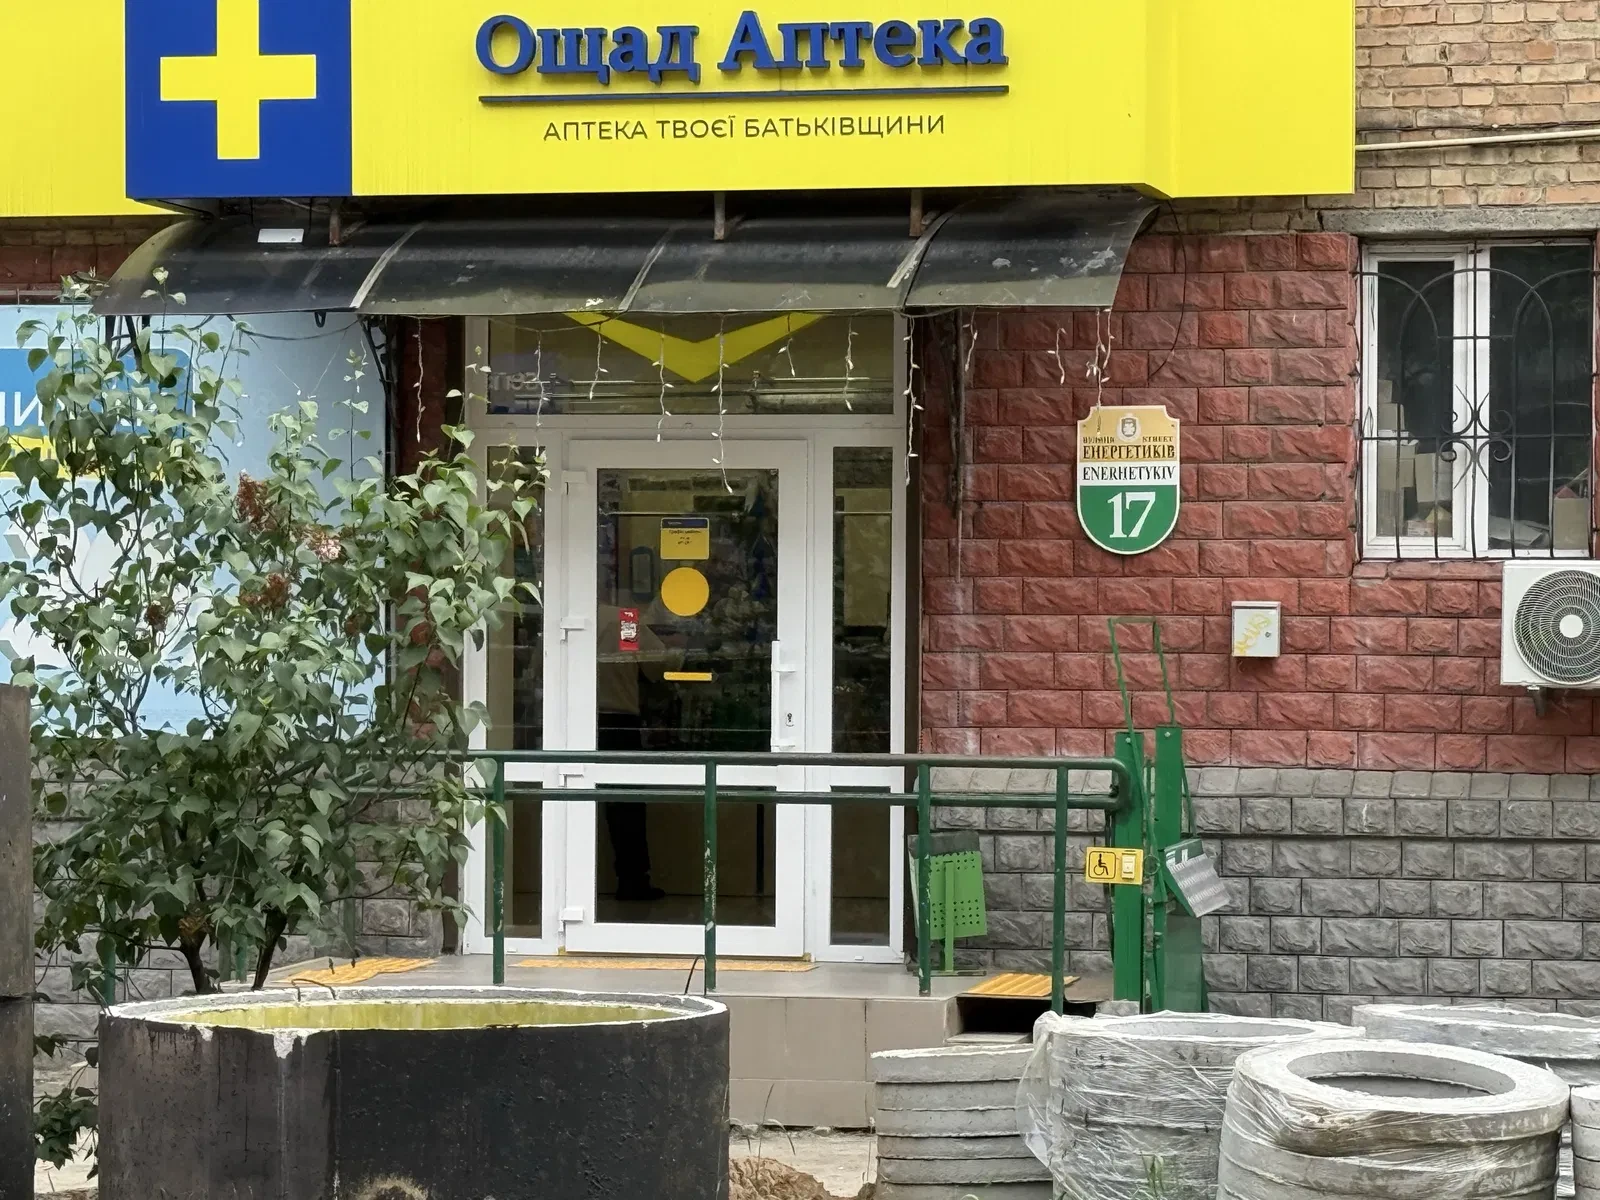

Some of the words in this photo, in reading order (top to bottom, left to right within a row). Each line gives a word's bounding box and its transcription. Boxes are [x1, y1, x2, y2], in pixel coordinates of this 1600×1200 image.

[475, 15, 701, 85] Ощад
[717, 11, 1009, 70] Аптека
[543, 119, 649, 141] АПТЕКА
[656, 115, 736, 140] ТВОЄЇ
[744, 114, 945, 139] БАТЬКІВЩИНИ
[1083, 444, 1175, 460] ЕНЕРГЕТИКІВ
[1083, 465, 1176, 480] ENERHETYKIV
[1107, 491, 1156, 538] 17
